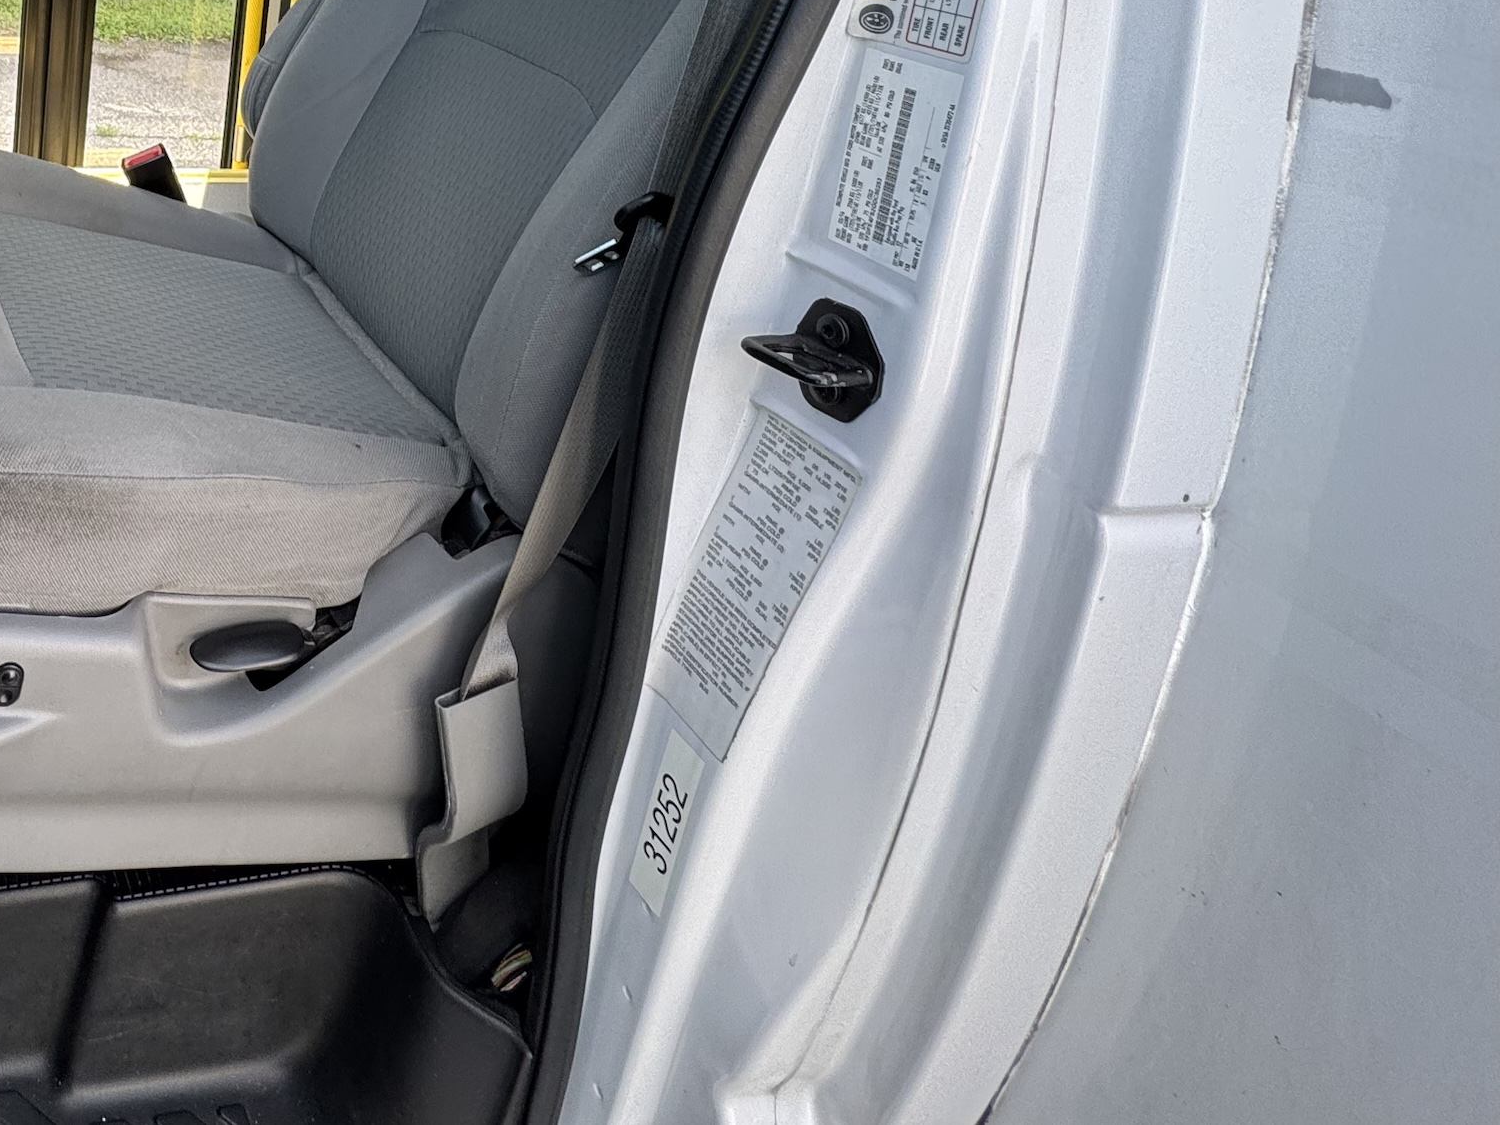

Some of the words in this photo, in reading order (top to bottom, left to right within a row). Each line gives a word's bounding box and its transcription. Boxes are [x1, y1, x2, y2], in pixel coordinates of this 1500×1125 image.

[911, 17, 921, 32] TIRE
[923, 16, 935, 39] FRONT
[938, 22, 949, 41] REAR
[953, 24, 965, 46] SPARE
[643, 773, 688, 875] 31252
